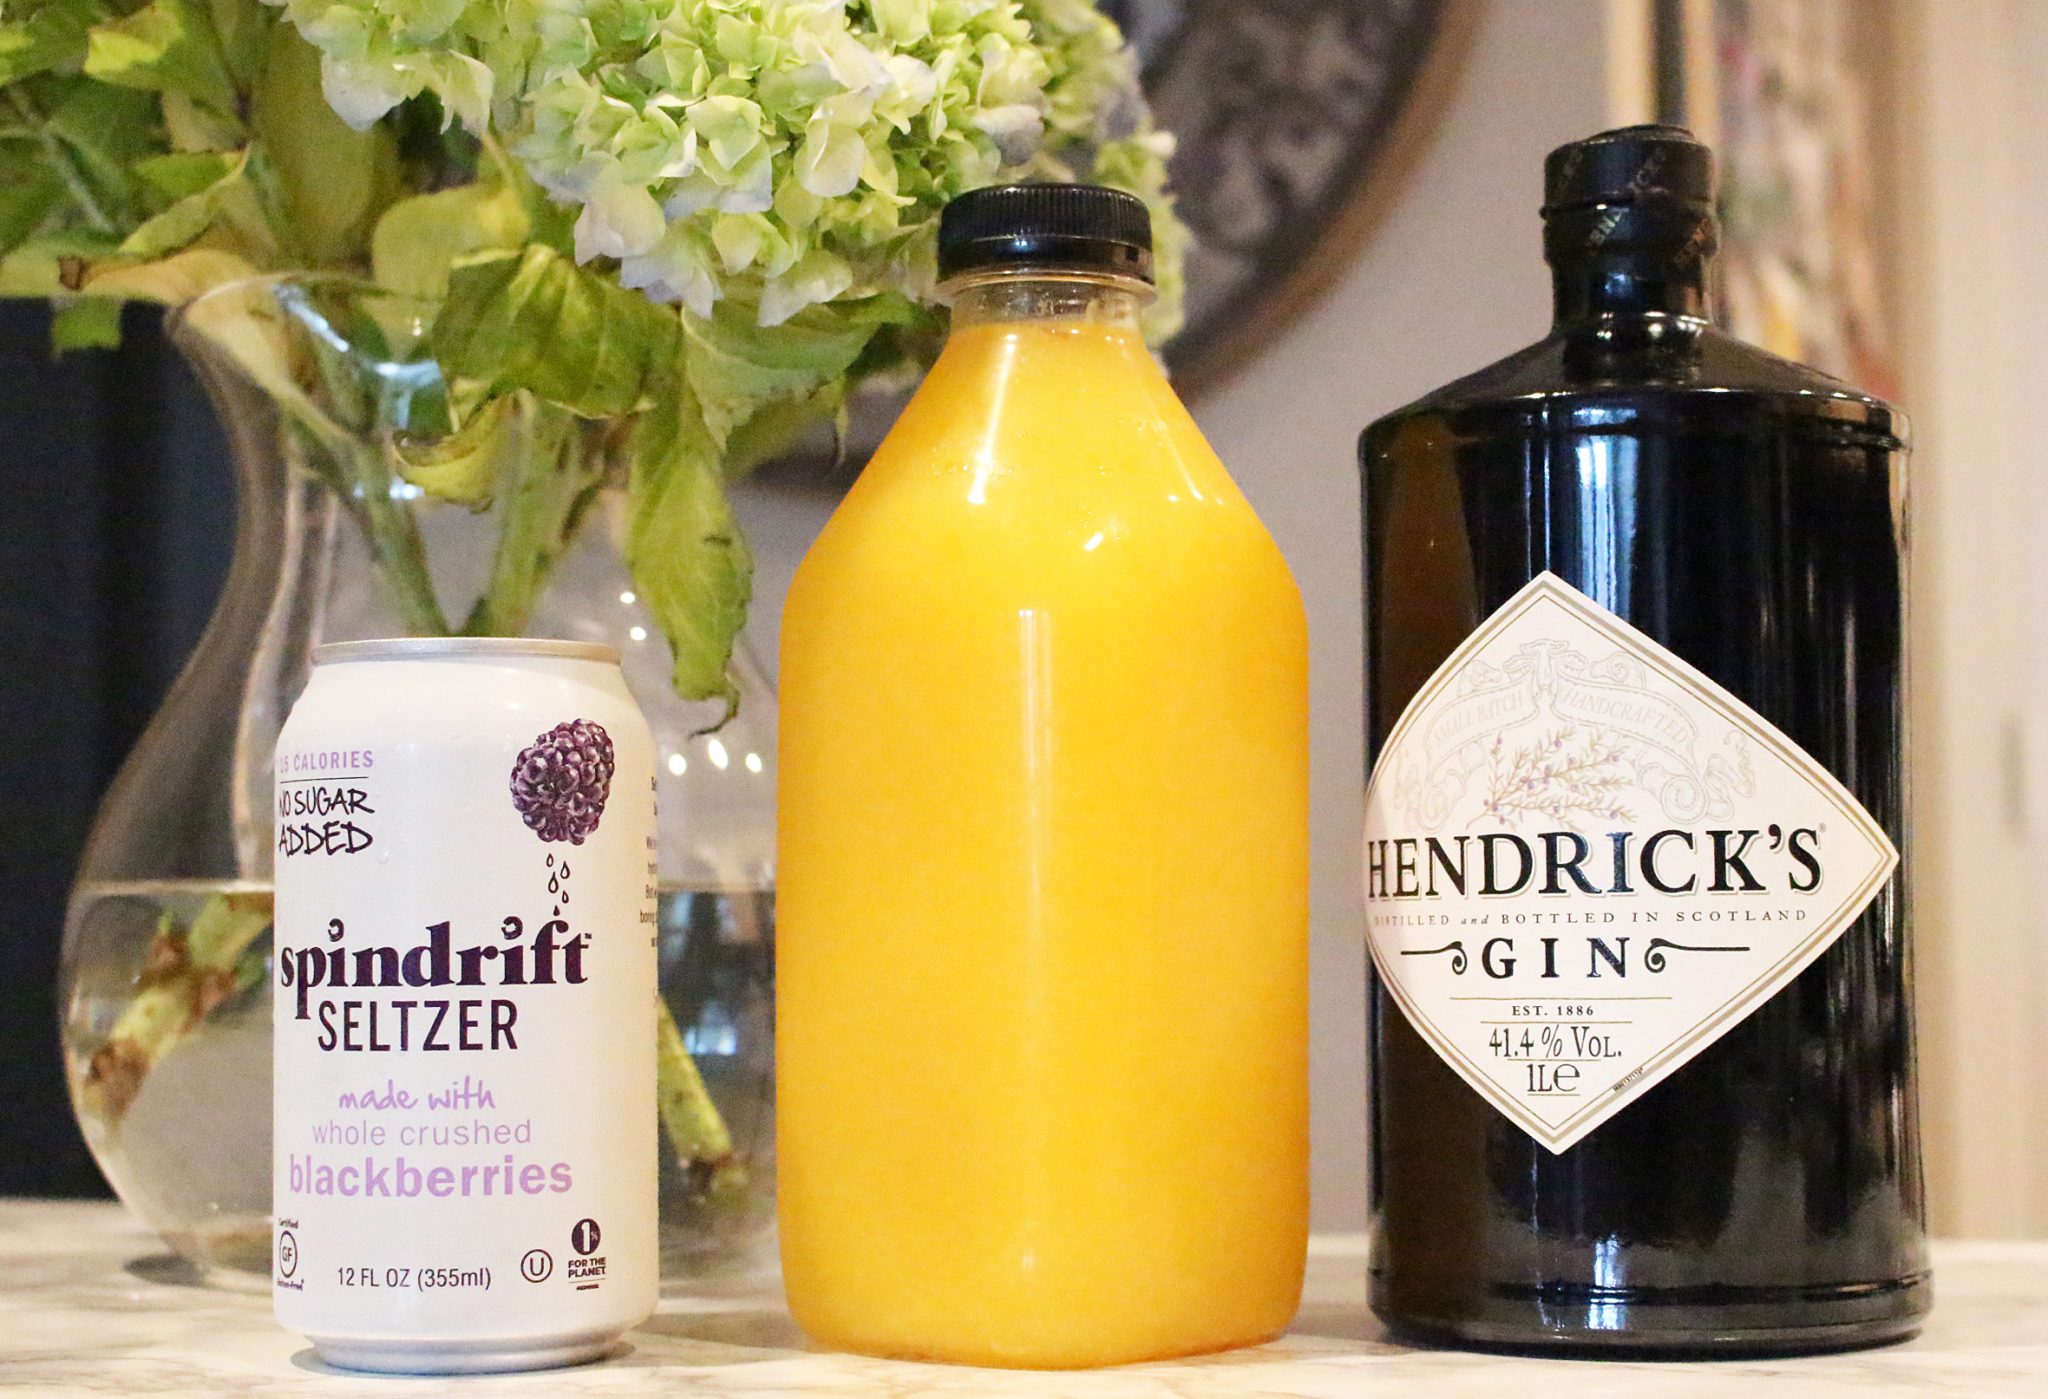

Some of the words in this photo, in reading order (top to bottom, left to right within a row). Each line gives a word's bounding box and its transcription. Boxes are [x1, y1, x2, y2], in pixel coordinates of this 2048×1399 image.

[1477, 690, 1523, 720] BATCH
[1562, 688, 1688, 744] HANDCRAFTED
[294, 750, 374, 772] CALORIES
[294, 786, 376, 816] SUGAR
[279, 820, 373, 858] ADDED
[1368, 822, 1823, 900] HENDRICK'S
[1460, 914, 1489, 926] and
[1501, 911, 1616, 925] BOTTLED
[1631, 911, 1660, 923] IN
[1676, 908, 1808, 923] SCOTLAND
[281, 916, 589, 1020] spindrift
[317, 999, 519, 1052] SELTZER
[1511, 1005, 1548, 1017] EST.
[1557, 1005, 1594, 1017] 1886
[338, 1078, 418, 1111] made
[428, 1075, 497, 1111] with
[312, 1119, 386, 1146] whole
[399, 1118, 532, 1146] crushed
[289, 1153, 574, 1198] blackberries
[567, 1259, 588, 1269] FOR
[589, 1256, 607, 1267] THE
[567, 1265, 607, 1279] PLANET
[337, 1267, 356, 1287] 12
[360, 1268, 380, 1288] FL
[385, 1267, 411, 1288] OZ
[417, 1266, 492, 1292] (355ml)
